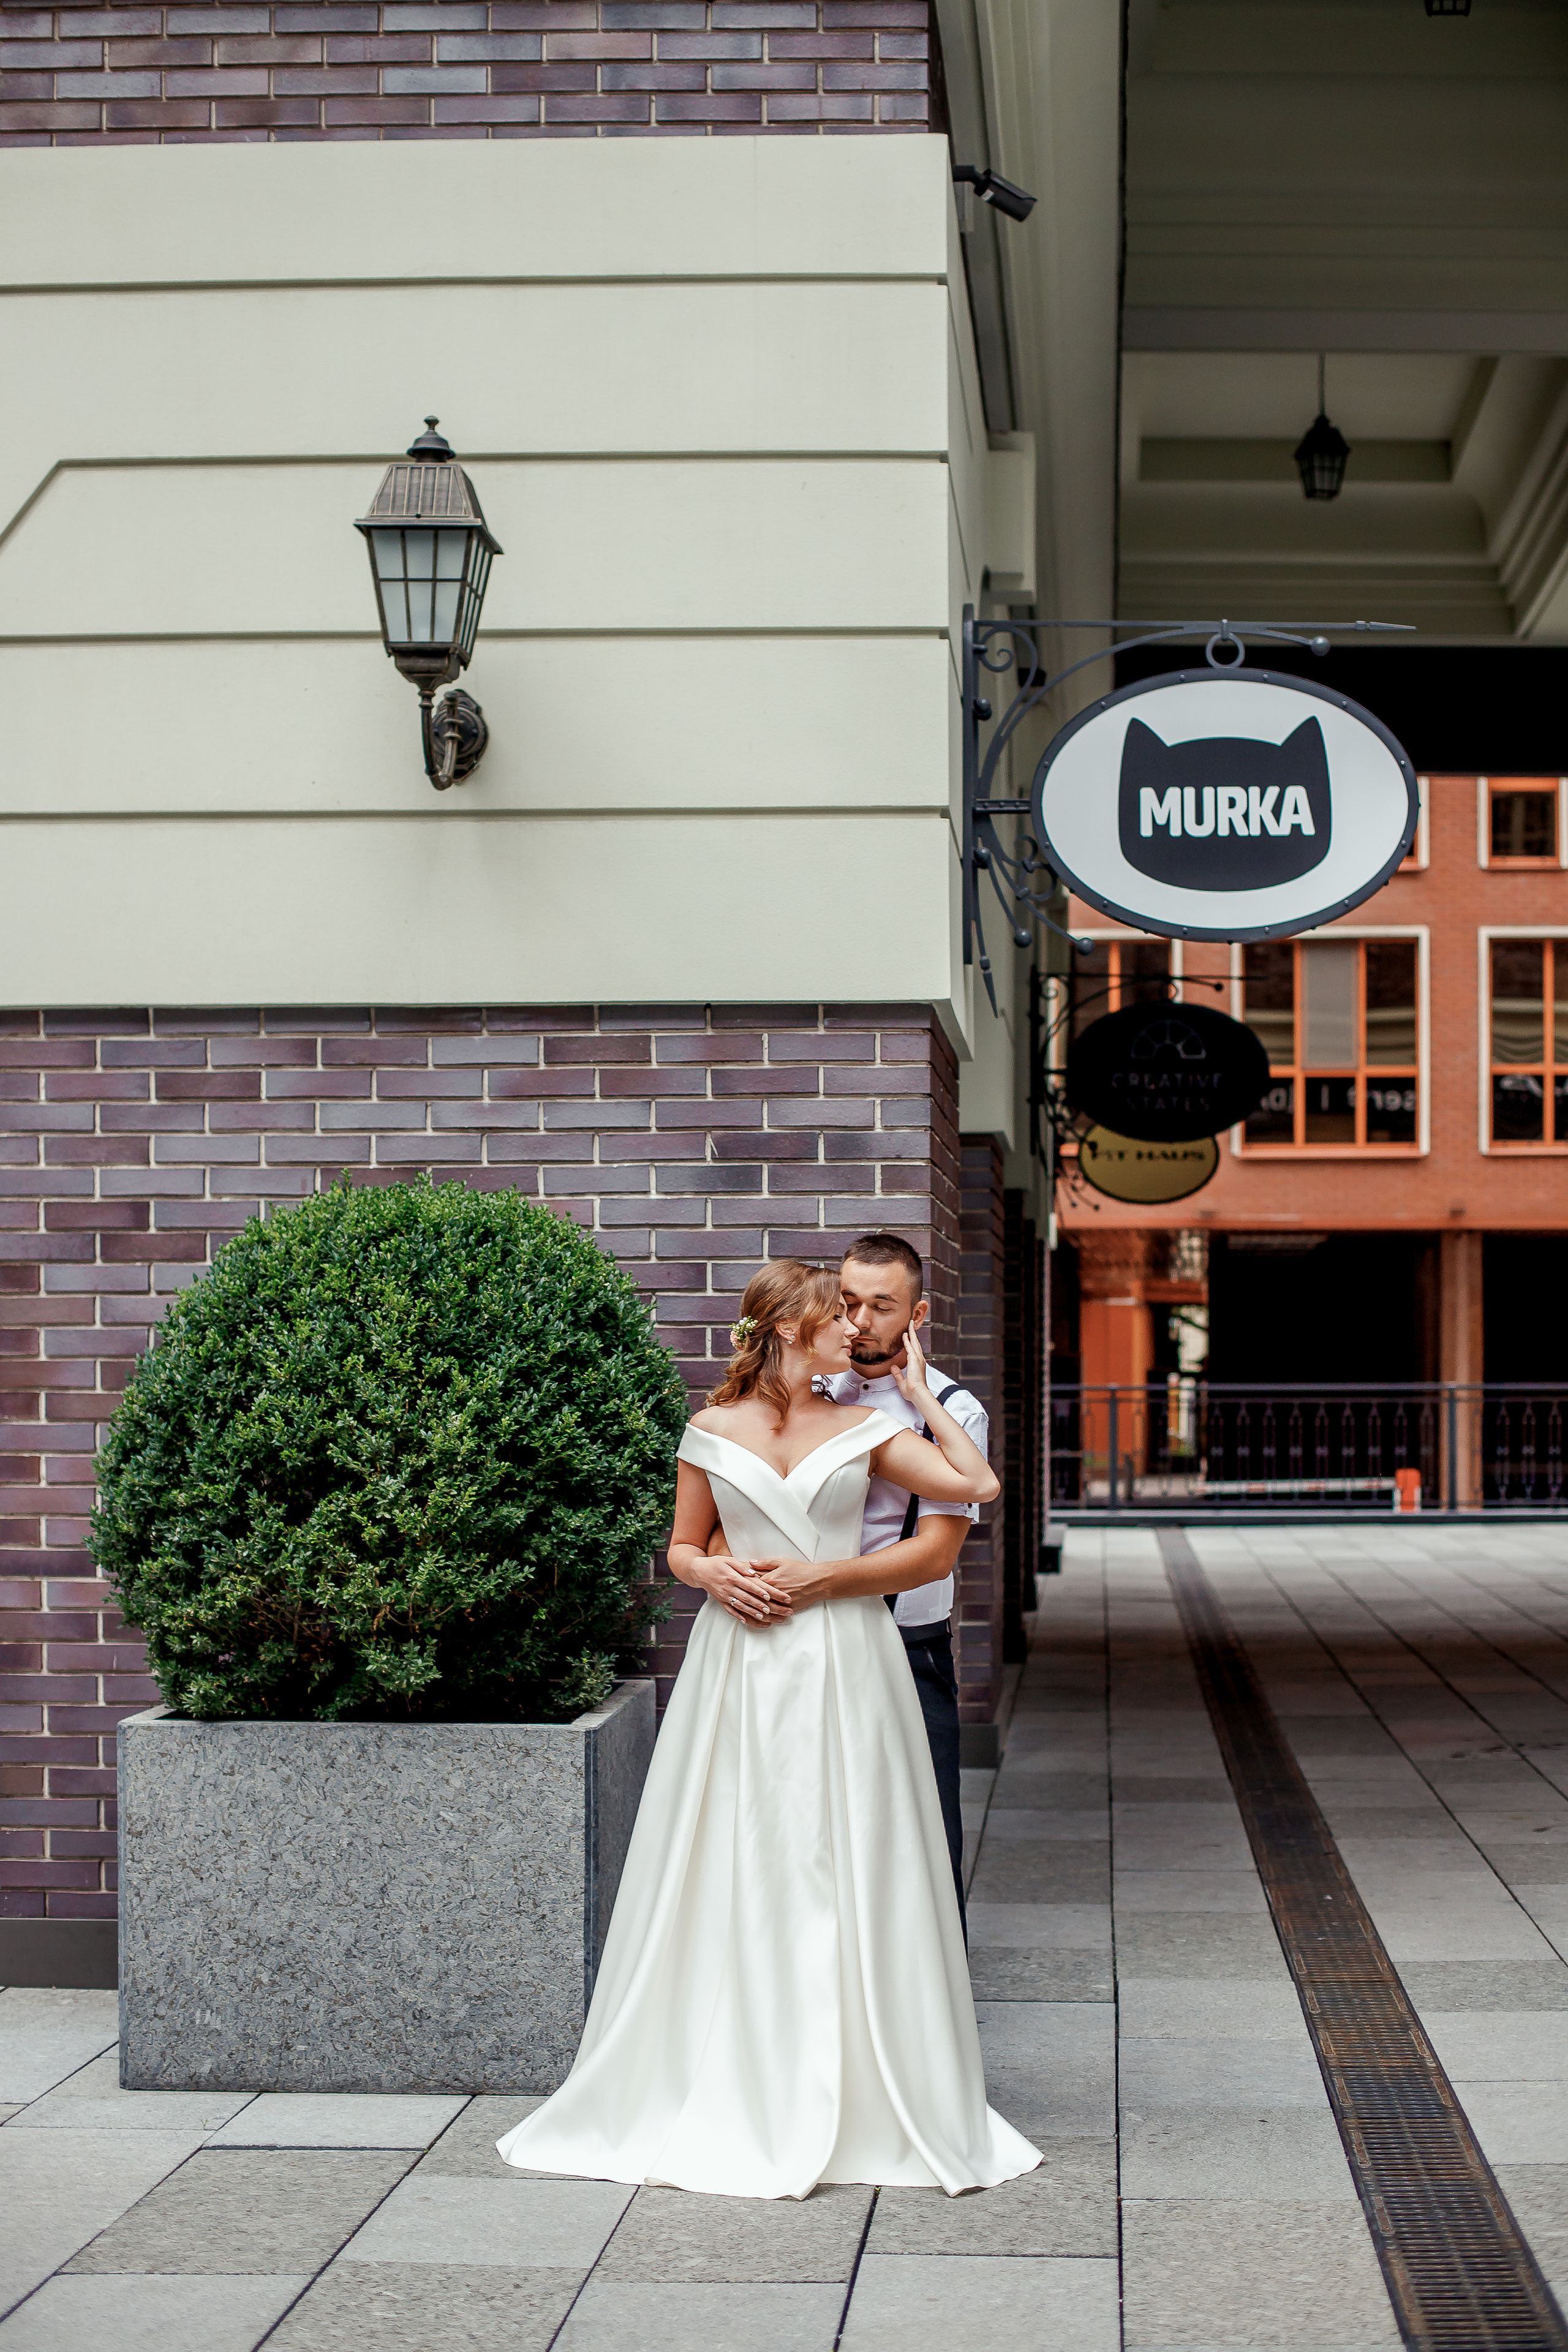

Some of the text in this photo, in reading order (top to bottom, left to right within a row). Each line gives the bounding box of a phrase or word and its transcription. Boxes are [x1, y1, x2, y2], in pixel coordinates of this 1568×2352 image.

[1139, 785, 1316, 837] MURKA
[1110, 1072, 1224, 1089] CREATIVE
[1125, 1094, 1211, 1112] STATES
